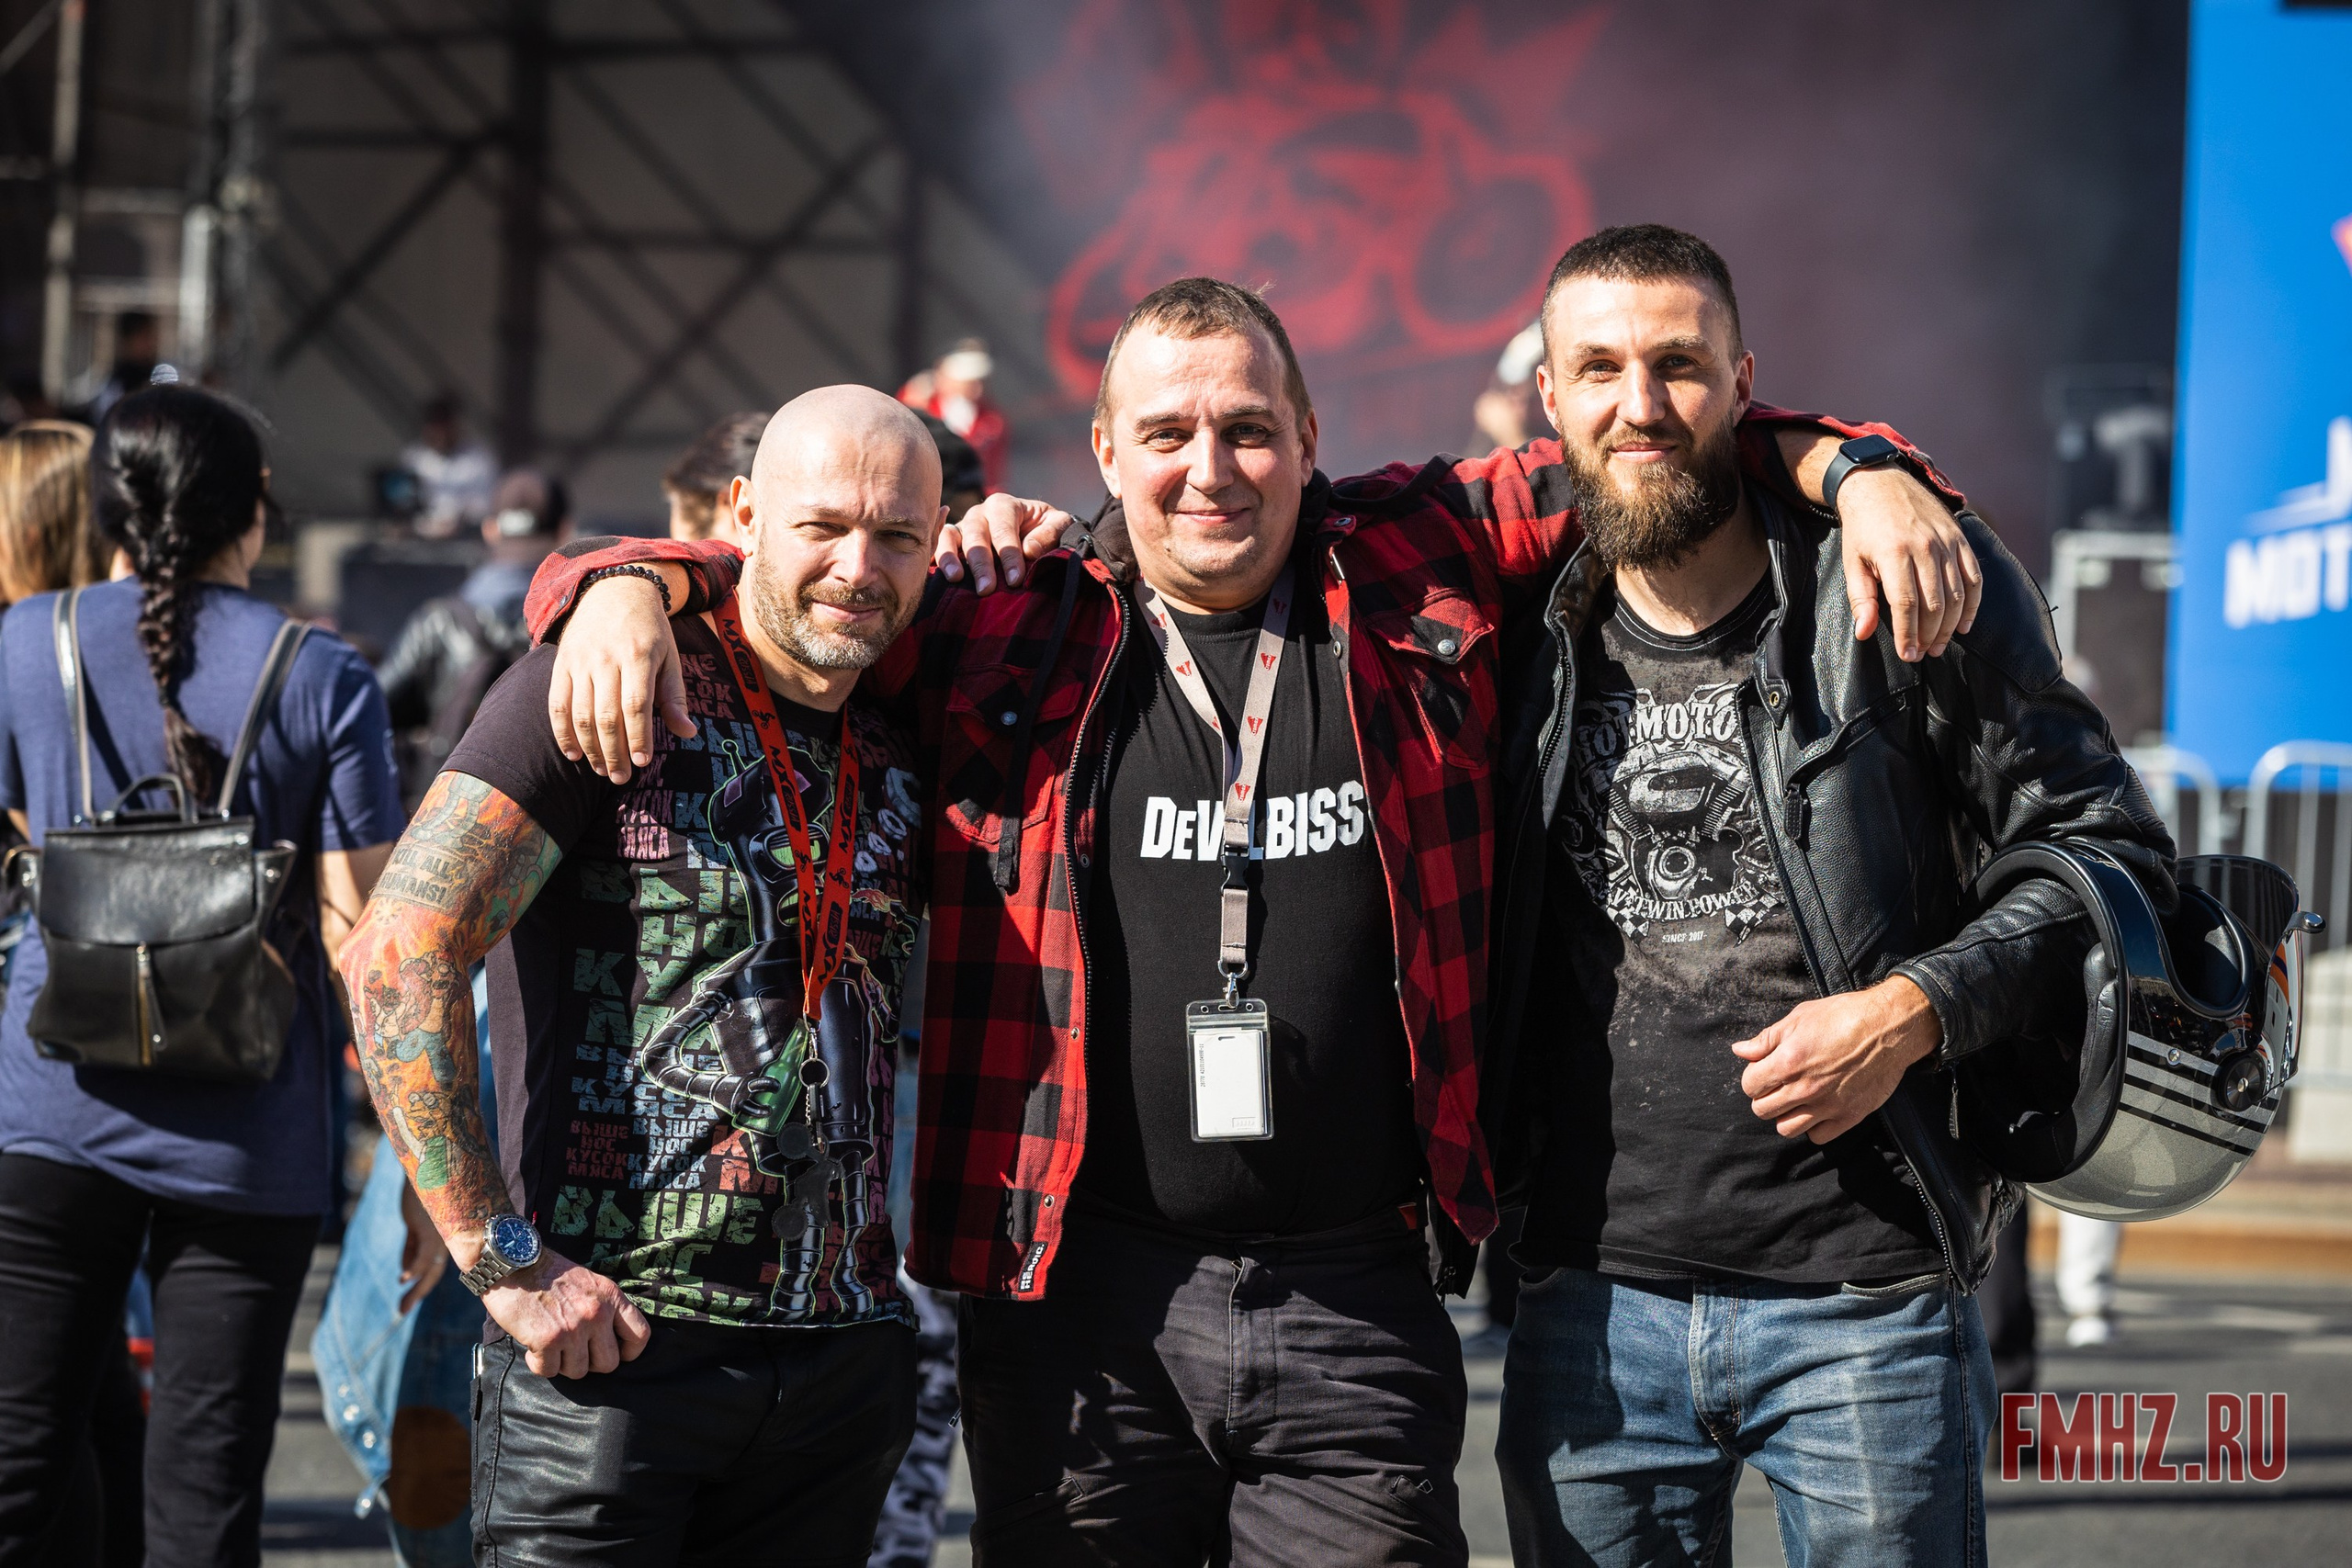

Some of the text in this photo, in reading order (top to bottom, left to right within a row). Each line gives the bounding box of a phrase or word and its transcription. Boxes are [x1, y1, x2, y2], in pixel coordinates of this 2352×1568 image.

[1687, 880, 1760, 918] POWER
[578, 1094, 720, 1121] МЯСА
[570, 1119, 630, 1140] ВЫШЕ
[632, 1117, 711, 1139] ВЫШЕ
[581, 1134, 617, 1153] НОС
[648, 1135, 694, 1156] НОС
[565, 1146, 628, 1168] КУСОК
[627, 1152, 708, 1173] КУСОК
[567, 1160, 625, 1180] МЯСА
[628, 1170, 702, 1190] МЯСА
[550, 1183, 765, 1246] ВЫШЕ
